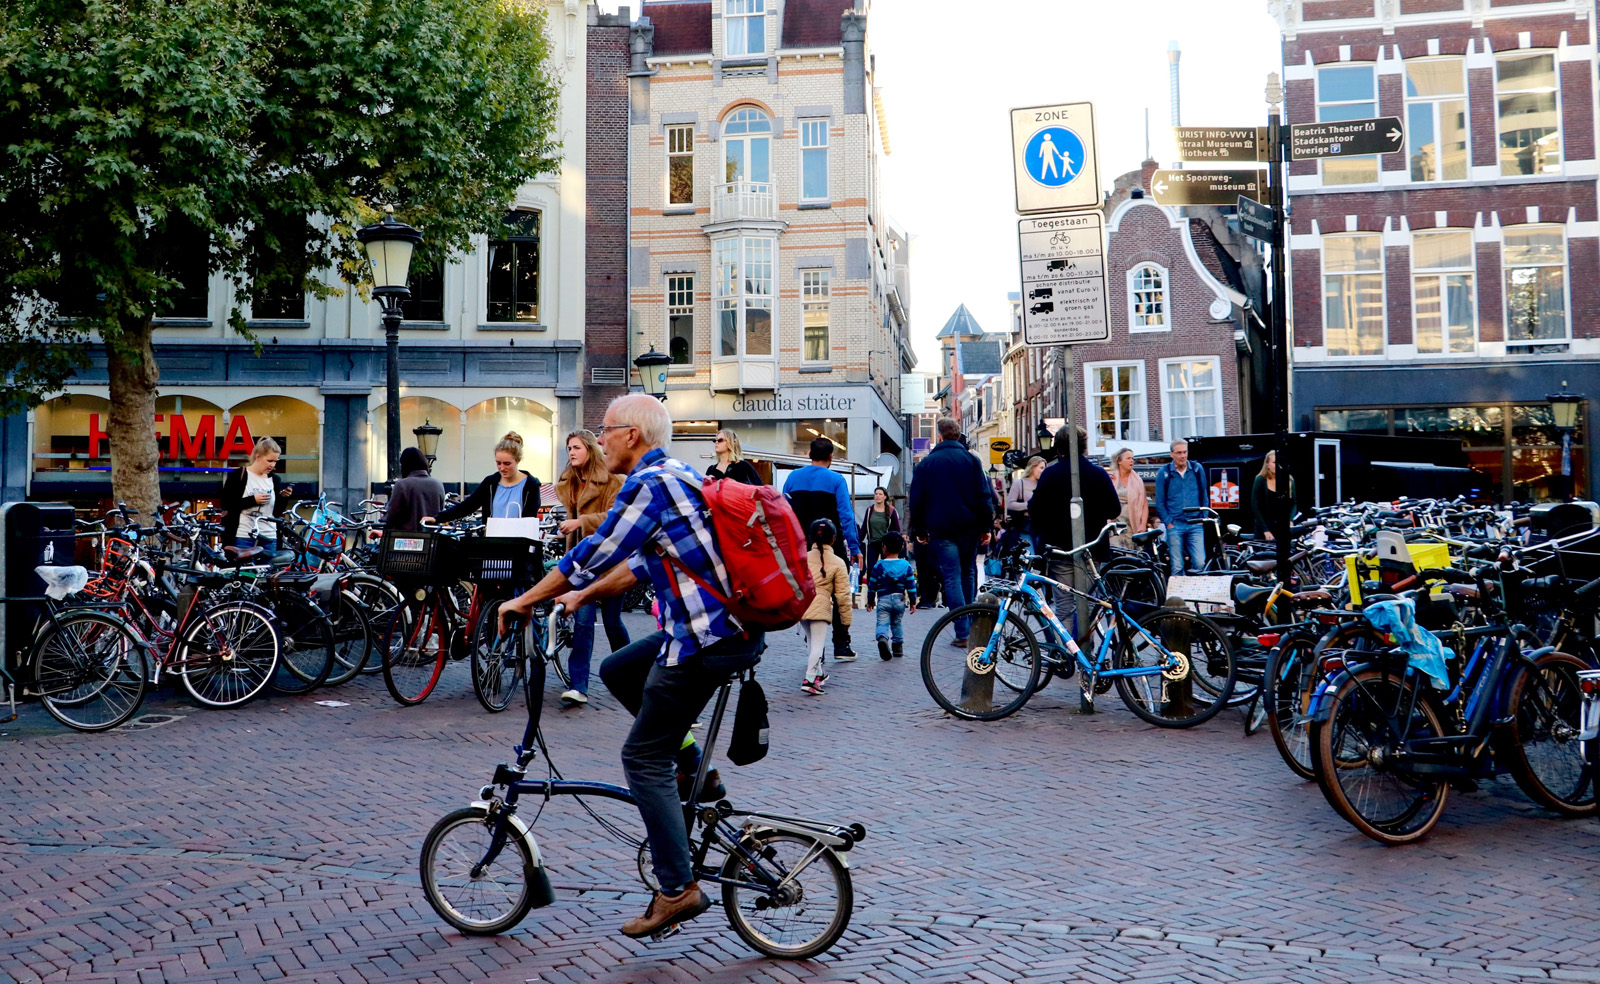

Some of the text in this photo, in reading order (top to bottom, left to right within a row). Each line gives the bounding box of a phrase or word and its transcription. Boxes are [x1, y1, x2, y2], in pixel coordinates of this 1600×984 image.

[1035, 110, 1069, 122] ZONE
[1206, 130, 1247, 138] INFO-VVV
[1294, 124, 1363, 136] Beatrix Theater
[1294, 135, 1354, 146] Stadskantoor
[1294, 146, 1329, 155] Overige
[1186, 174, 1232, 183] Spoorweg-
[1032, 218, 1088, 229] Toegestaan
[732, 394, 856, 412] claudia sträter
